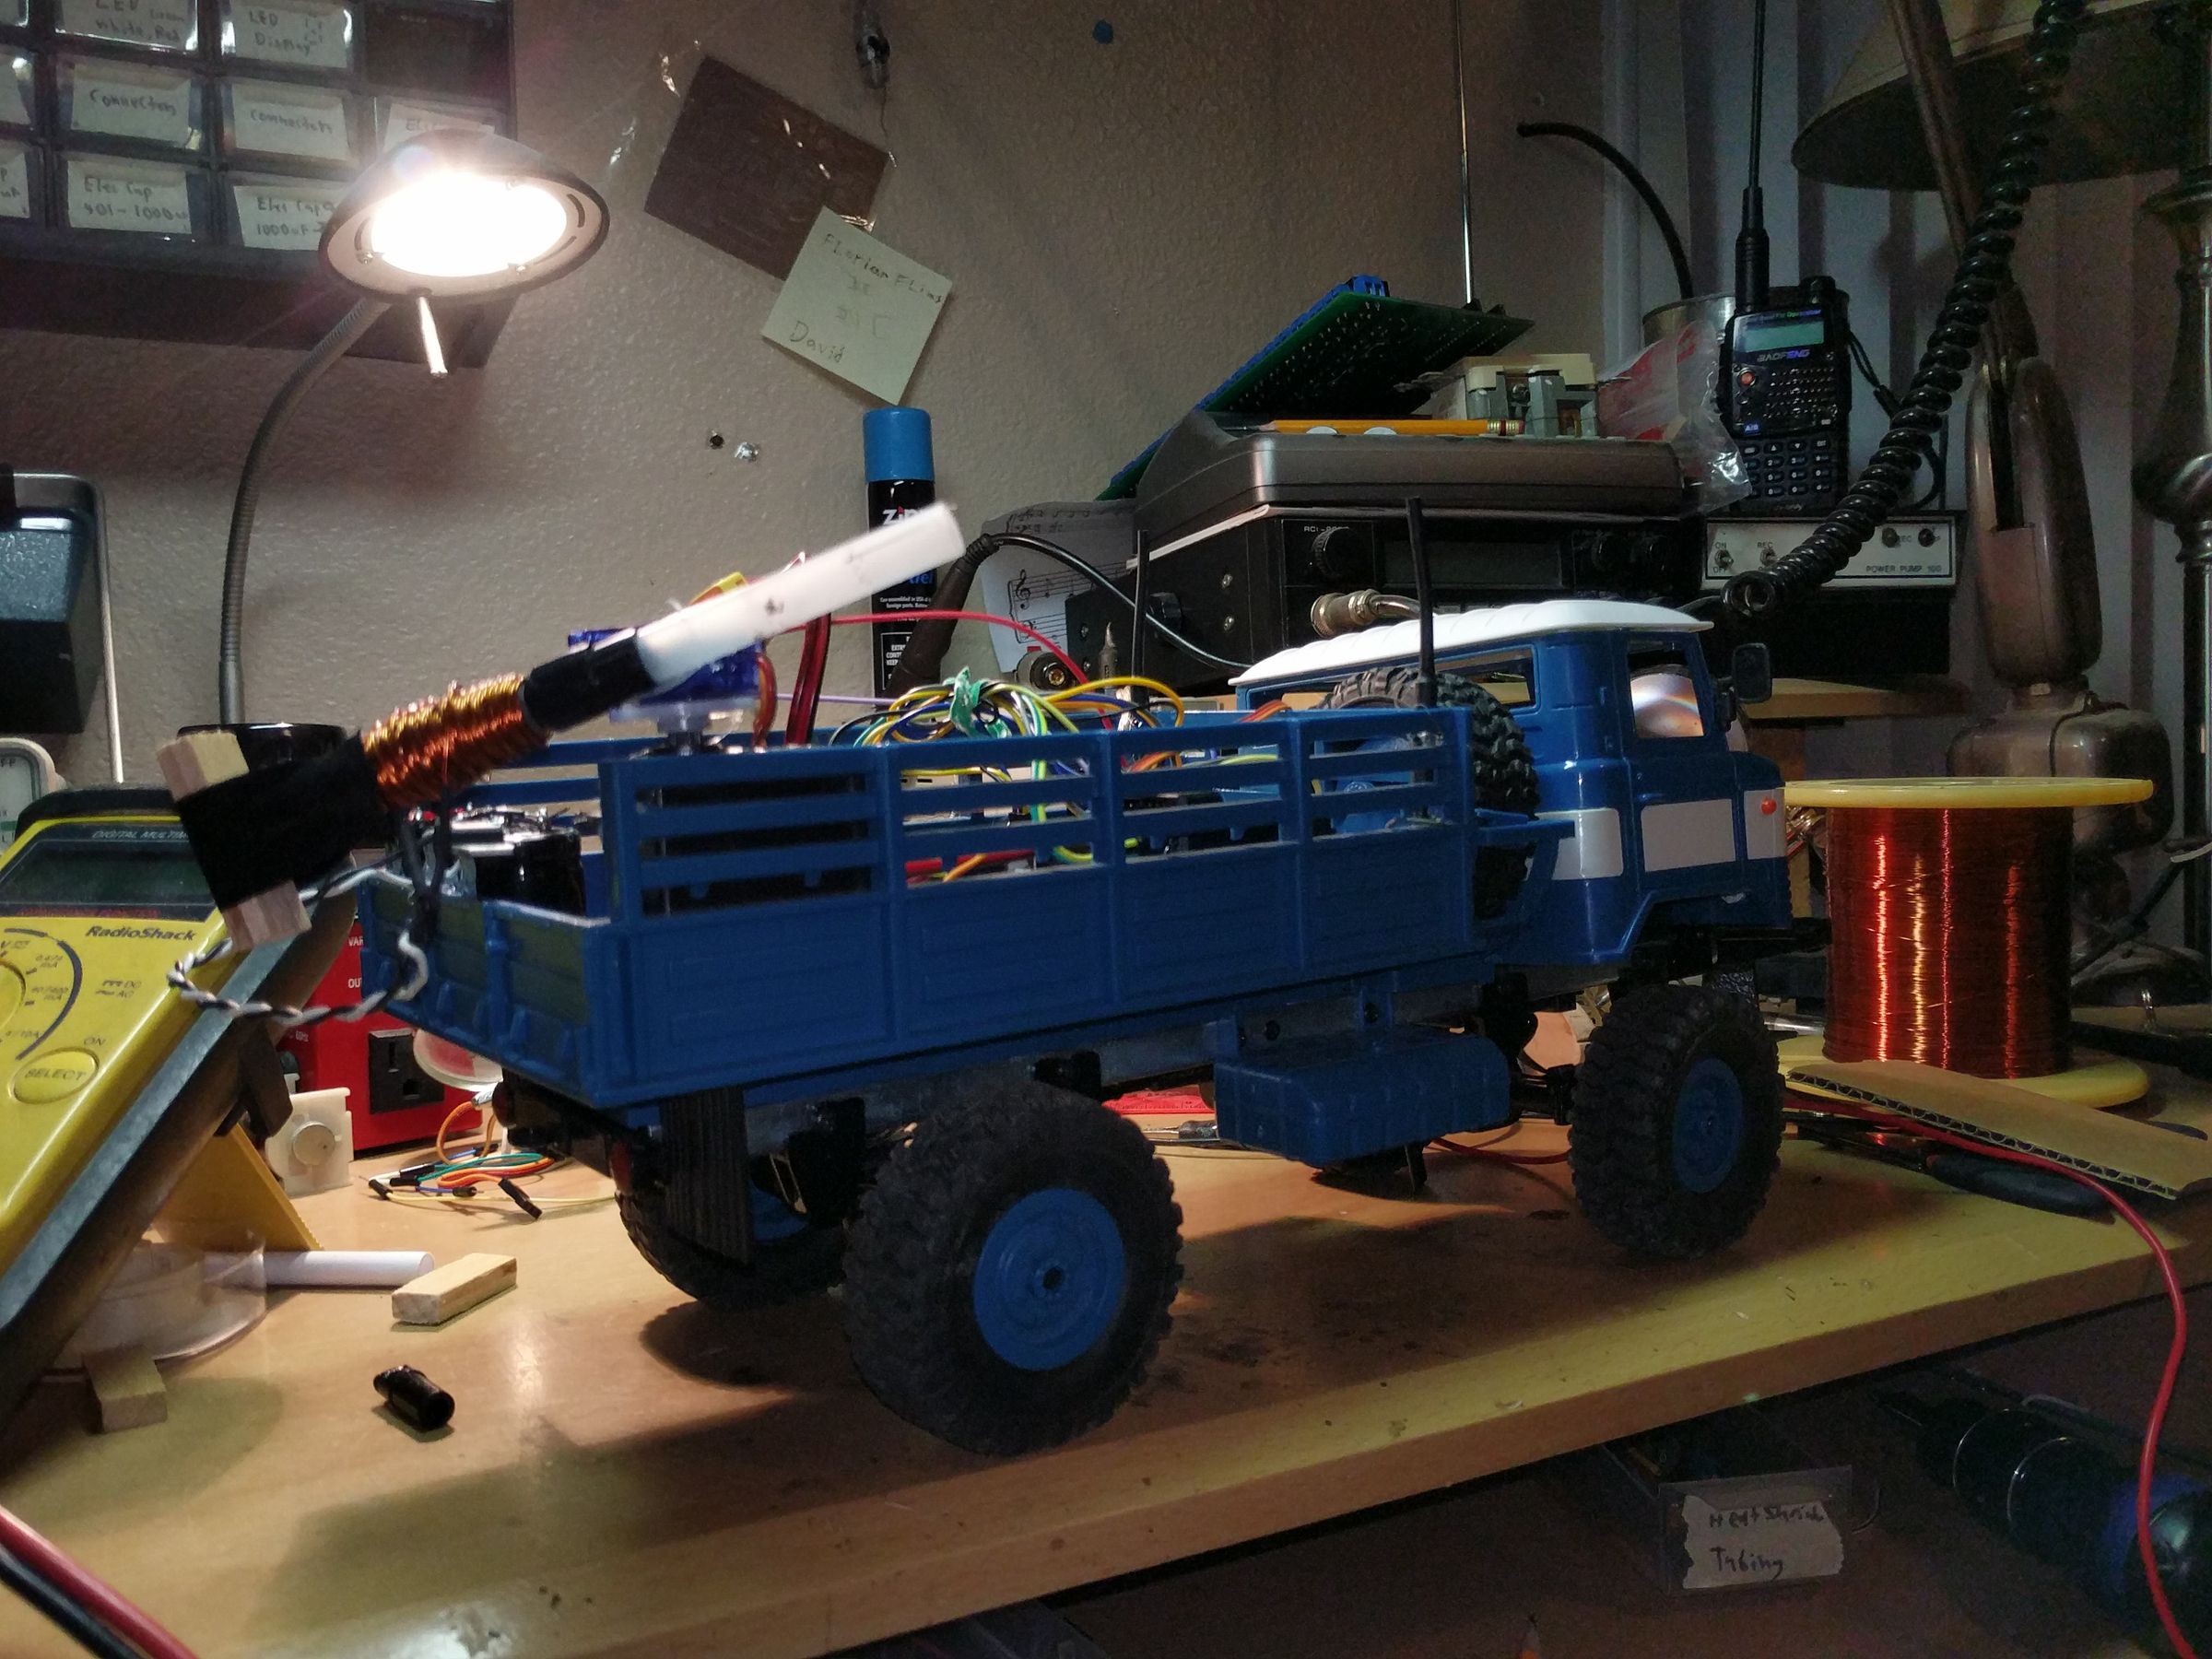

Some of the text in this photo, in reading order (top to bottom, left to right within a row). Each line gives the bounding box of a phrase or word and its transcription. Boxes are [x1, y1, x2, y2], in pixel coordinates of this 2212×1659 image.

[249, 10, 278, 27] LED
[789, 319, 846, 364] David
[1715, 541, 1727, 549] ON
[1865, 565, 1896, 573] POWER
[85, 924, 196, 941] RadioShack
[83, 1037, 107, 1047] ON
[24, 1067, 87, 1081] SELECT
